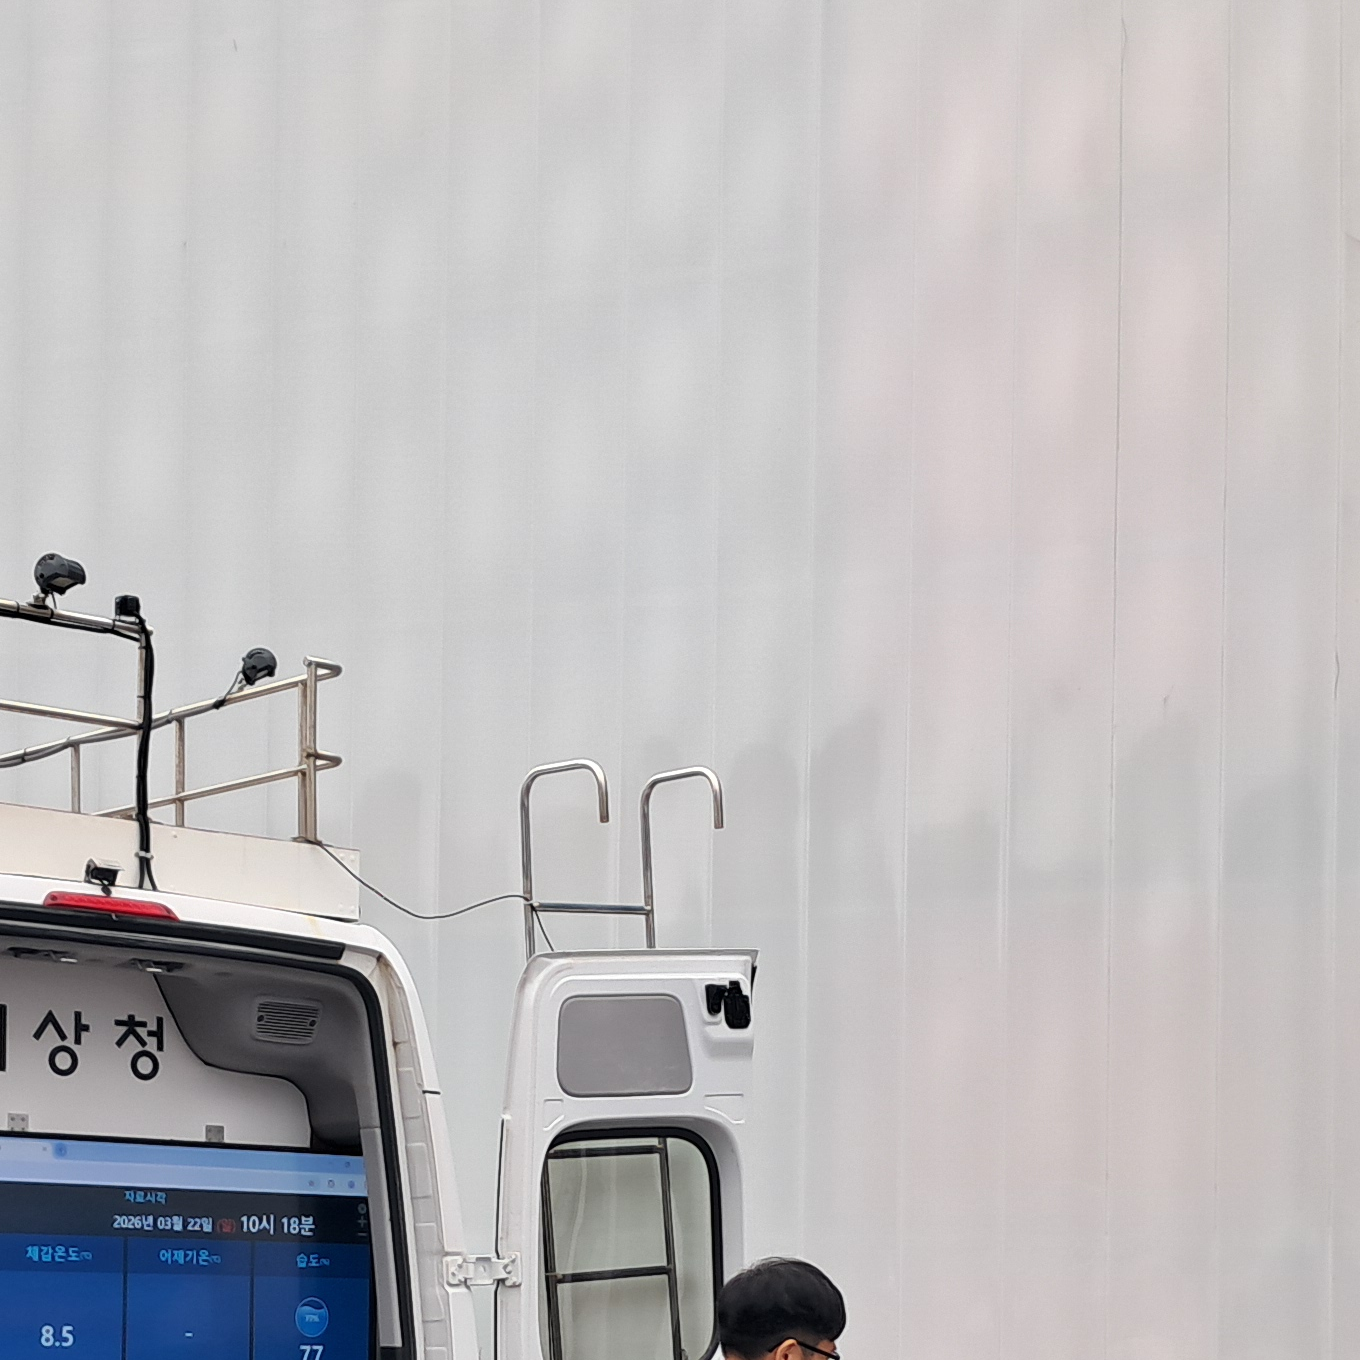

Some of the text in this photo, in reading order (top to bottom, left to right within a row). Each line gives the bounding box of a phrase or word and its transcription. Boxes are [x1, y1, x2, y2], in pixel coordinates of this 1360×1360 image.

[124, 1190, 167, 1205] 자료시각
[112, 1214, 154, 1232] 2026년
[157, 1216, 184, 1233] 03월
[186, 1217, 214, 1234] 22일
[240, 1213, 276, 1236] 10시
[281, 1216, 316, 1237] 18분
[40, 1324, 74, 1347] 8.5
